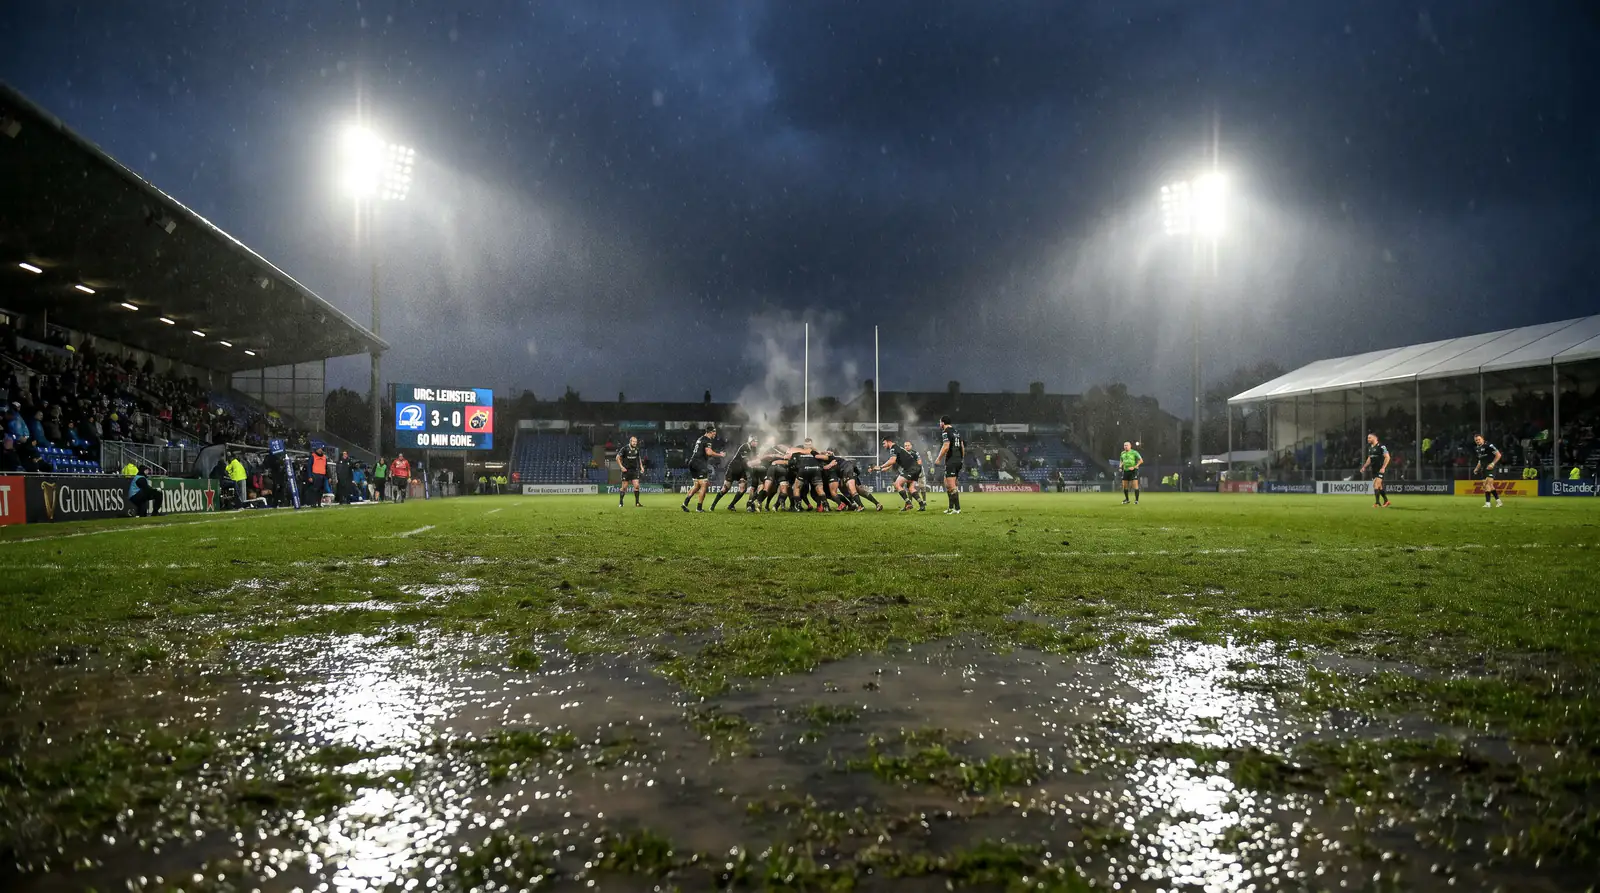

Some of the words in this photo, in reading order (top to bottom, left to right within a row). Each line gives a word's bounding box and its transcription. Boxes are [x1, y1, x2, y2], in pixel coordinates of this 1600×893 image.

[413, 388, 435, 401] URC:
[436, 389, 476, 403] LEINSTER
[431, 410, 440, 426] 3
[452, 411, 461, 427] 0
[417, 433, 430, 446] 60
[431, 434, 449, 446] MIN
[450, 435, 475, 447] GONE.
[0, 485, 11, 516] T
[59, 485, 125, 513] GUINNESS
[147, 480, 204, 513] ineken
